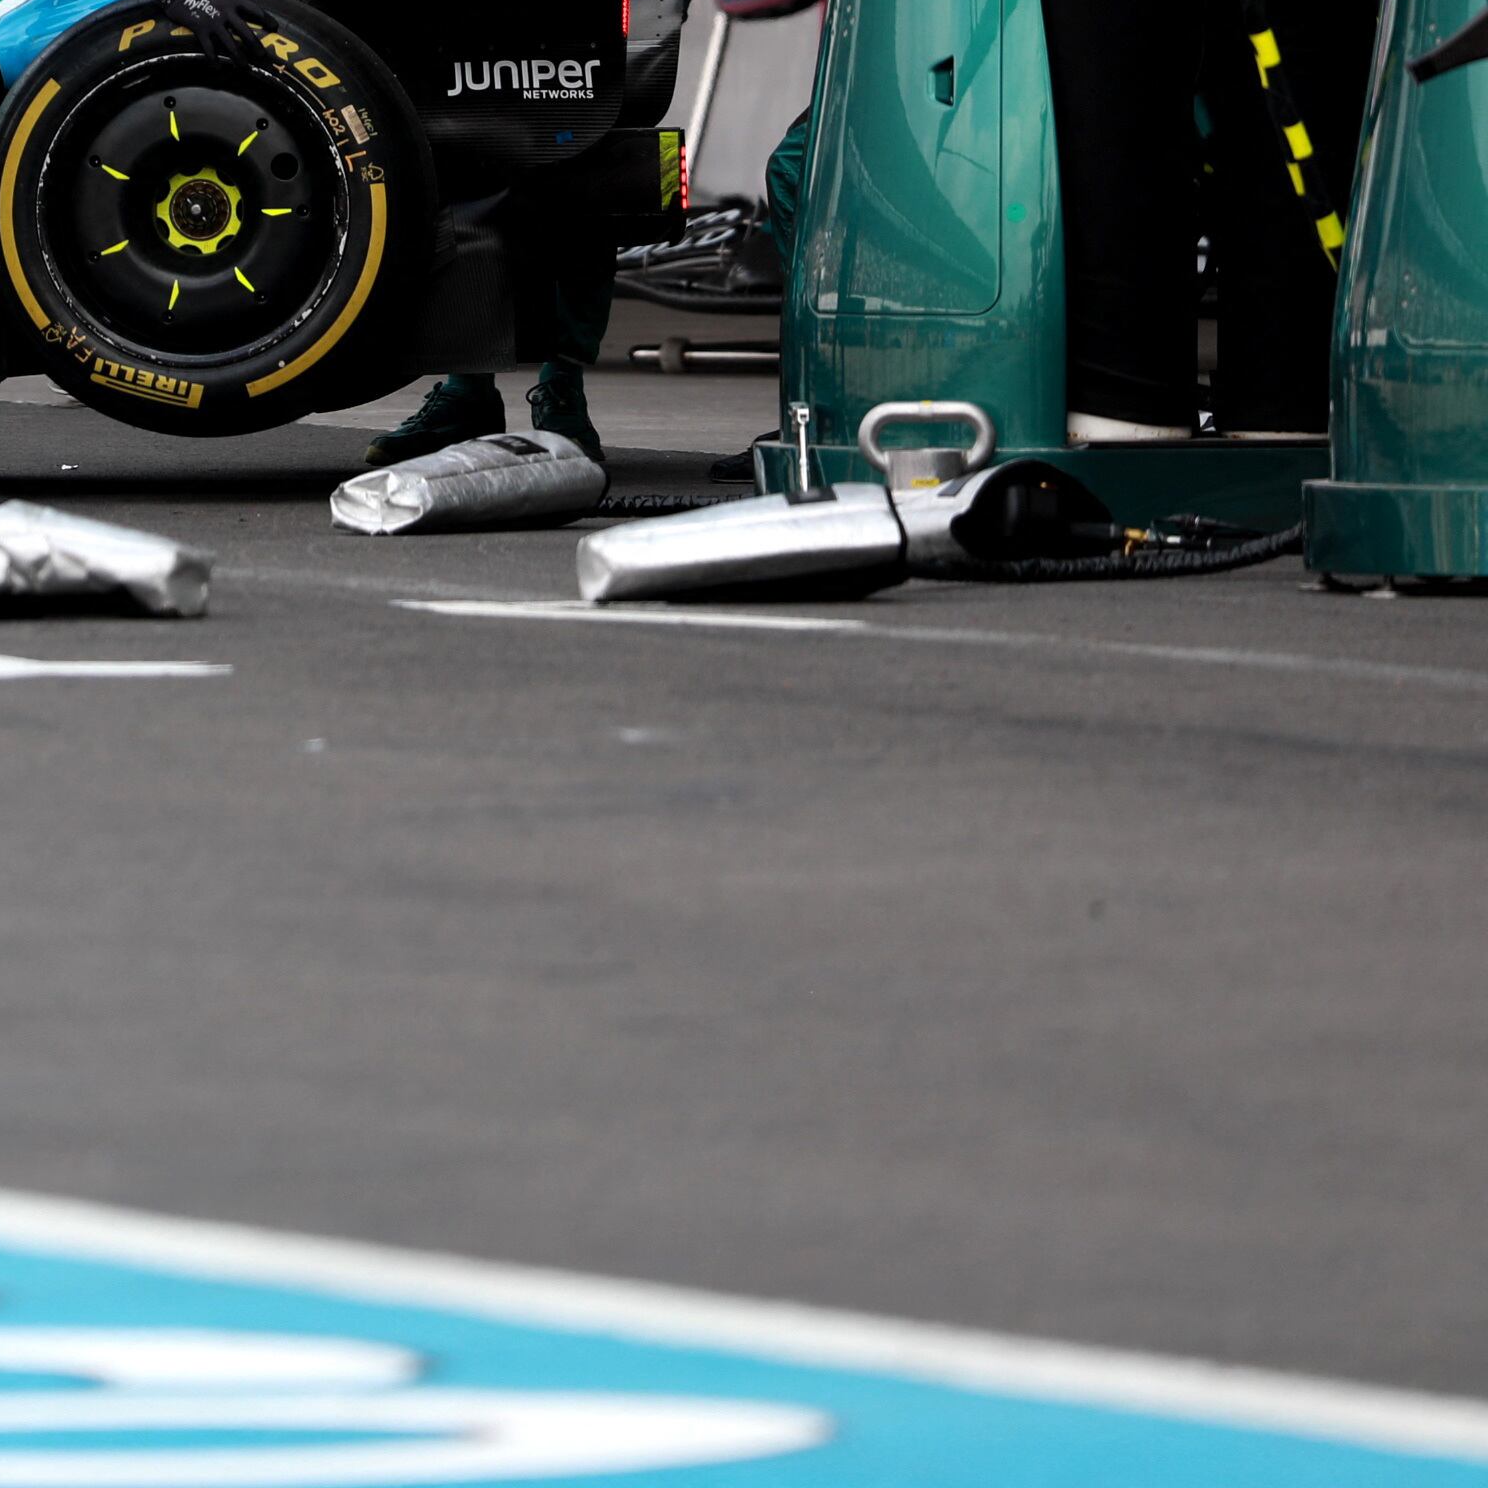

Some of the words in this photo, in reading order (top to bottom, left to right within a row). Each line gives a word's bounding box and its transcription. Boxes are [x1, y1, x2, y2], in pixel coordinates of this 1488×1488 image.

[118, 19, 156, 52] P
[523, 89, 594, 100] NETWORKS
[90, 357, 204, 409] PIRELLI
